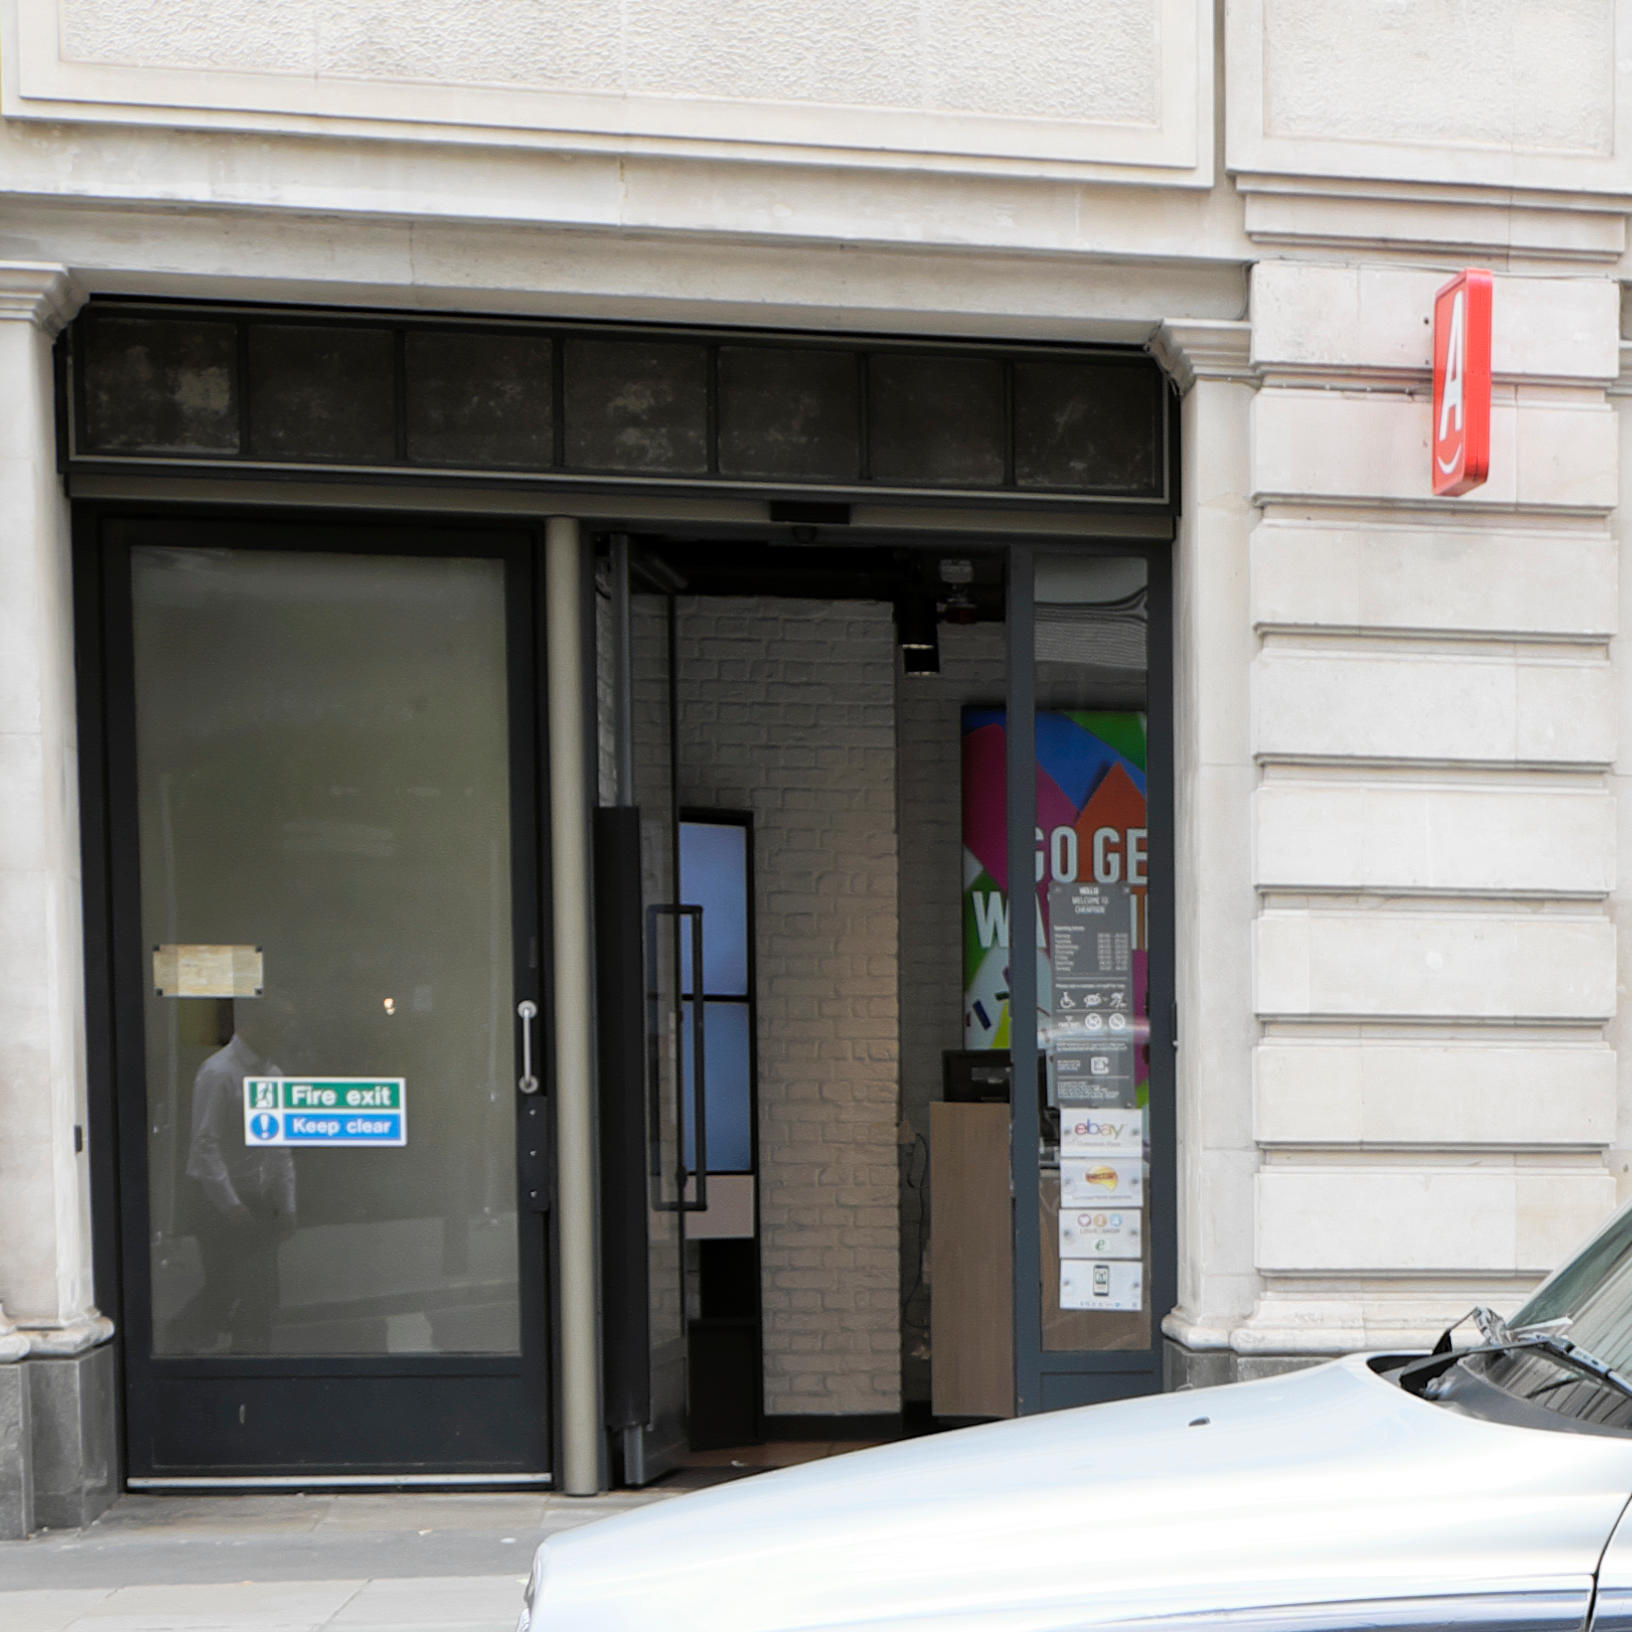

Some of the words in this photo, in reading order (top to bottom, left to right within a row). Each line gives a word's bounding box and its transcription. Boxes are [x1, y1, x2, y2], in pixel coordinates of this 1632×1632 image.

[291, 1085, 337, 1106] Fire
[346, 1086, 392, 1106] exit
[292, 1118, 340, 1136] Keep
[346, 1118, 392, 1134] clear
[1074, 1117, 1124, 1140] ebay
